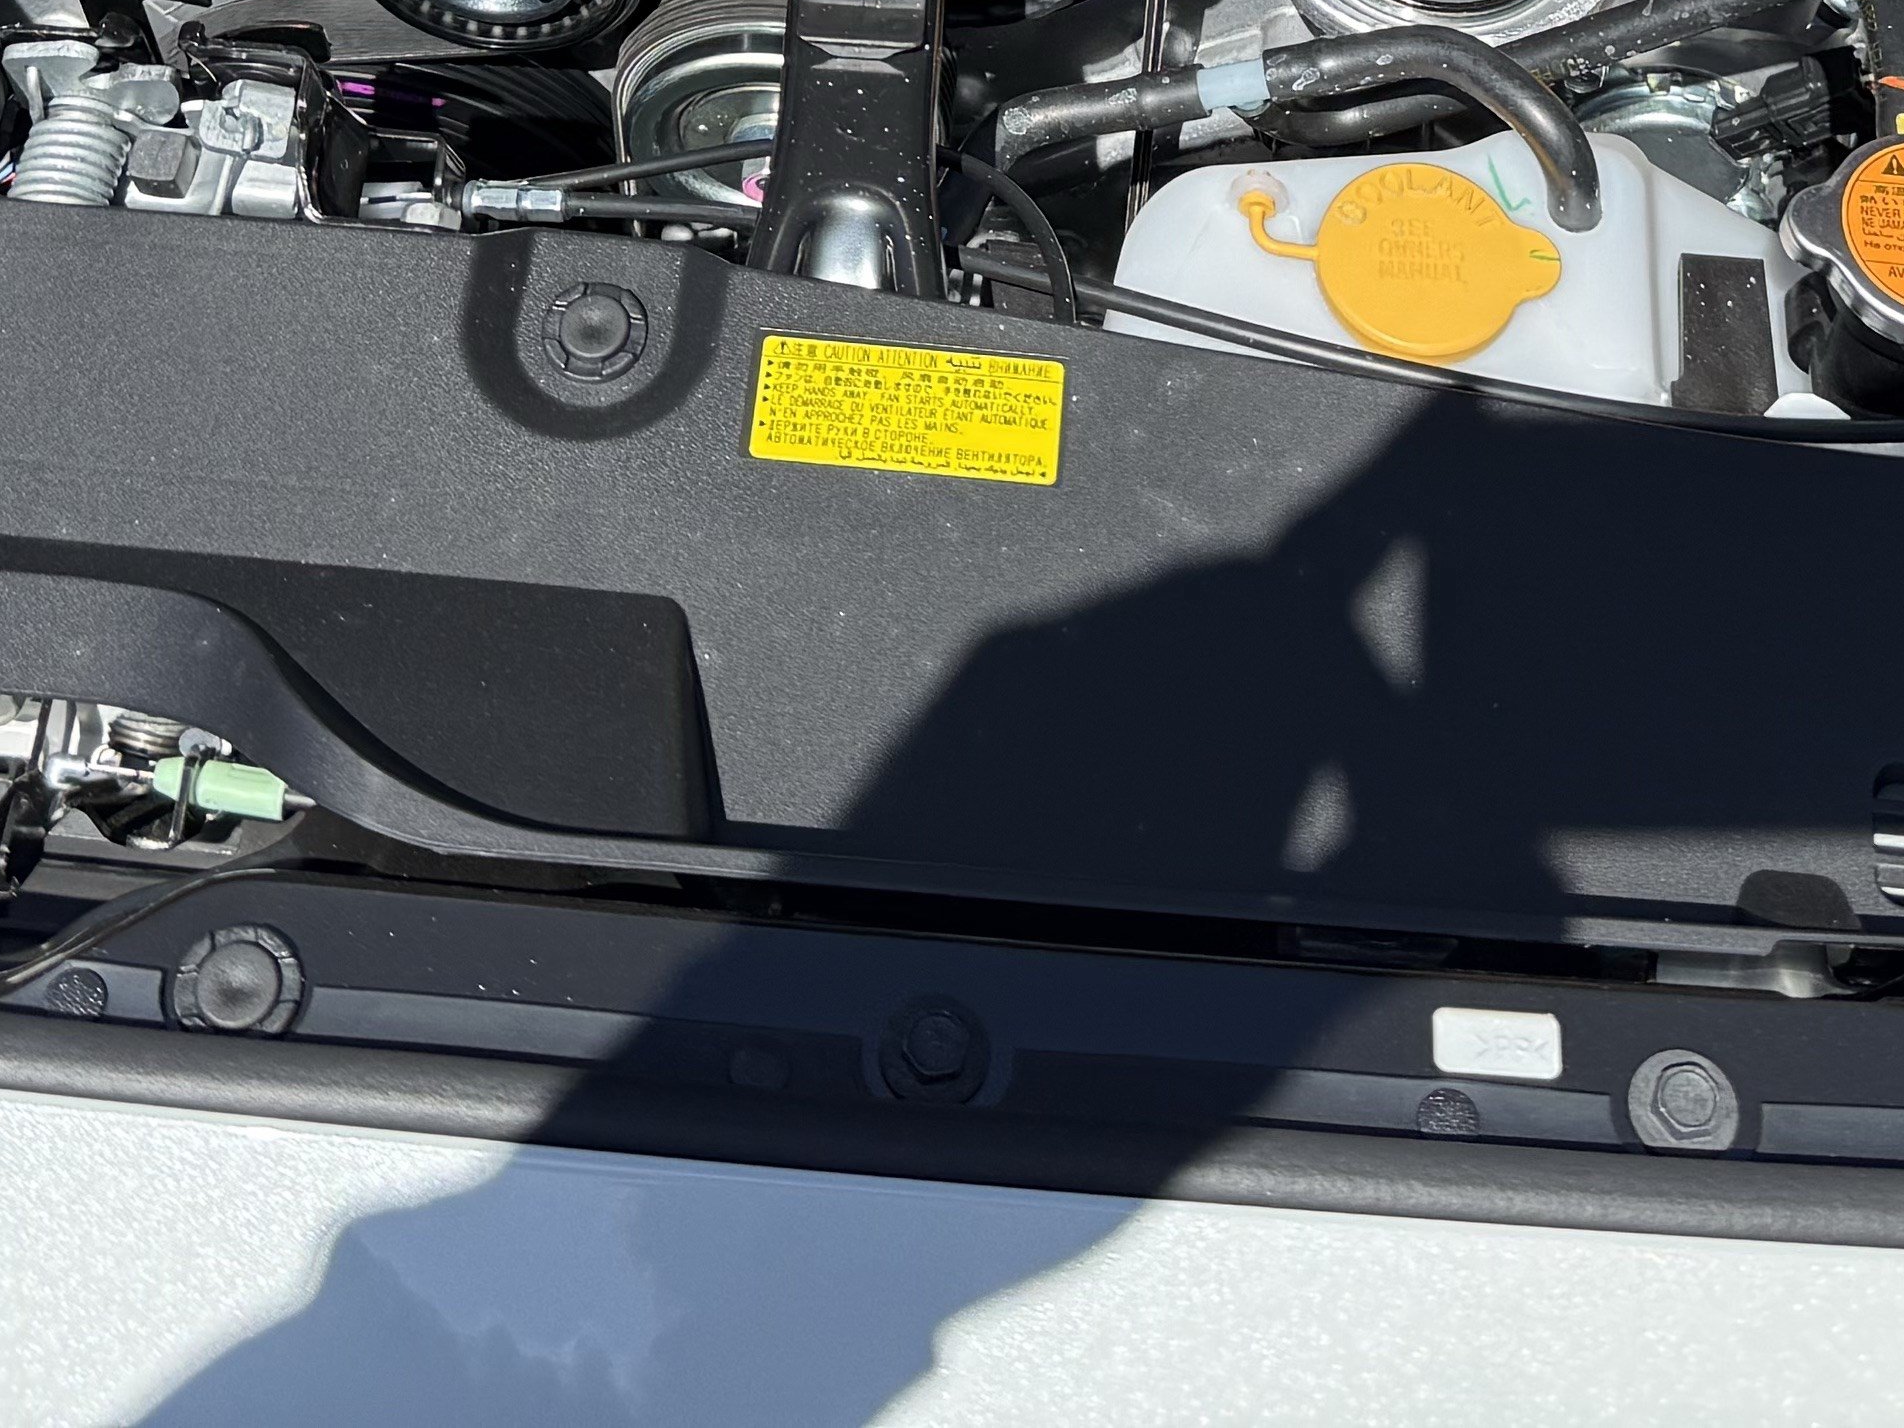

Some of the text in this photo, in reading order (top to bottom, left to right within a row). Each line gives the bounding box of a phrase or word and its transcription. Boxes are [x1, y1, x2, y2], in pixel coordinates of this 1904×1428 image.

[1336, 163, 1501, 236] COOLANT
[1859, 205, 1902, 219] NEVER
[822, 343, 872, 363] CAUTION
[877, 348, 938, 369] ATTENTION
[770, 393, 783, 405] LE
[849, 401, 864, 412] DU
[868, 402, 937, 418] VENTILATEUR
[772, 381, 799, 394] KEEP
[804, 385, 836, 397] HANDS
[879, 391, 900, 402] FAN
[904, 394, 945, 408] STARTS
[802, 409, 864, 425] APPROCHEZ
[869, 415, 891, 427] PAS
[896, 417, 918, 430] LES
[862, 428, 870, 439] В
